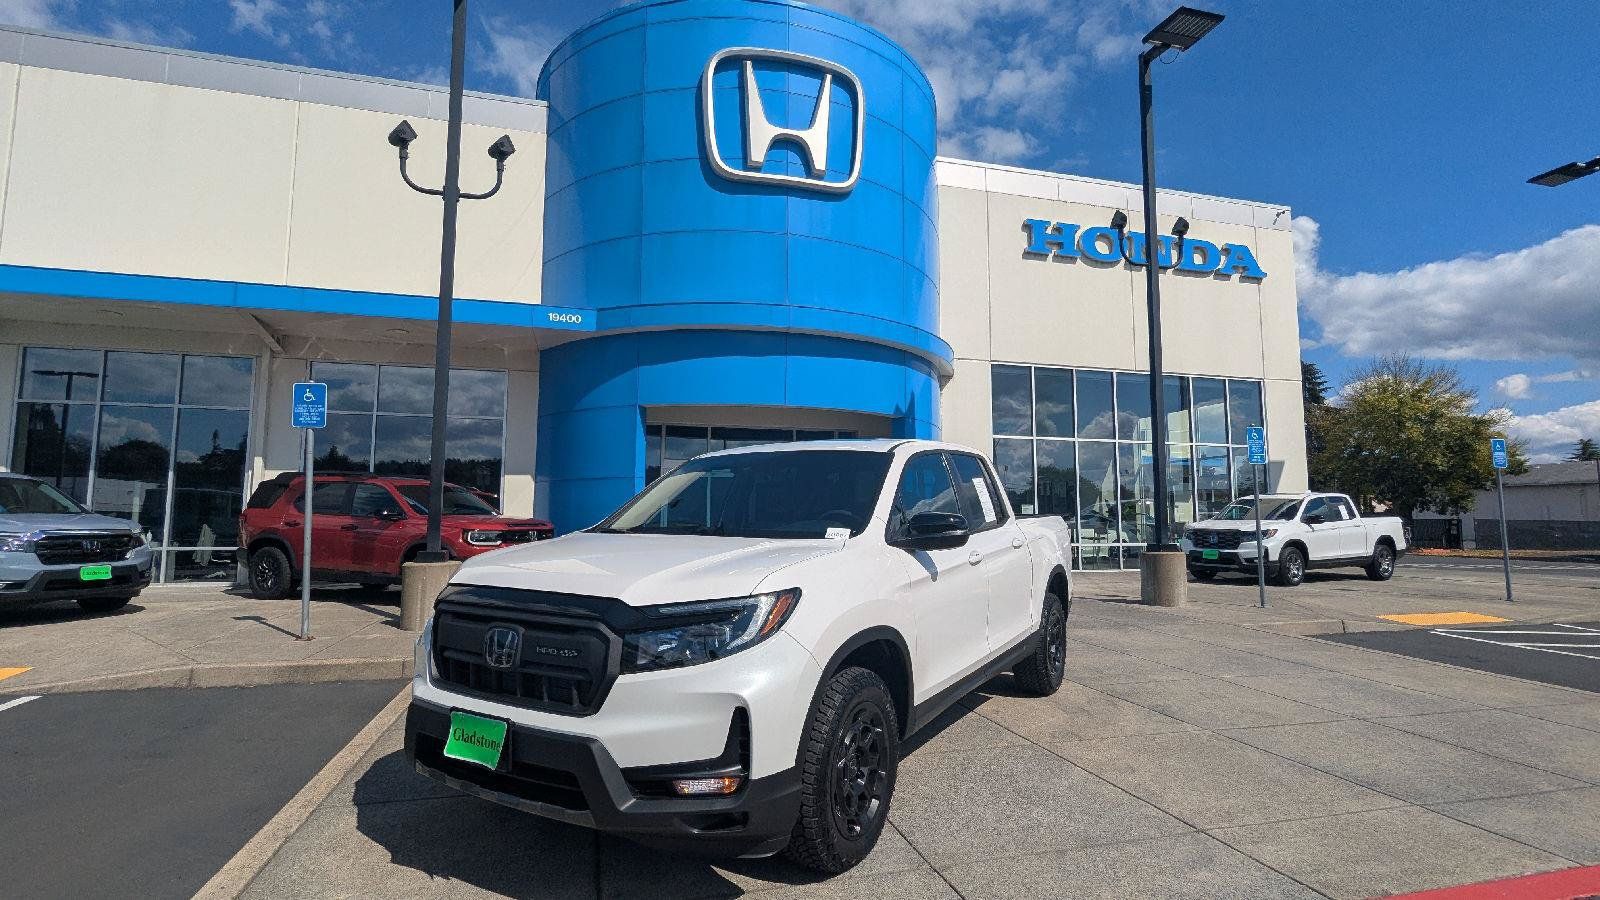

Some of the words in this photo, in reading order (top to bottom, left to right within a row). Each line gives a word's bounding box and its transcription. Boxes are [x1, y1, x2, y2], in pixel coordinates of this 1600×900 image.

[1022, 218, 1268, 283] HONDA
[547, 312, 582, 324] 19400
[453, 727, 502, 752] Gladstone
